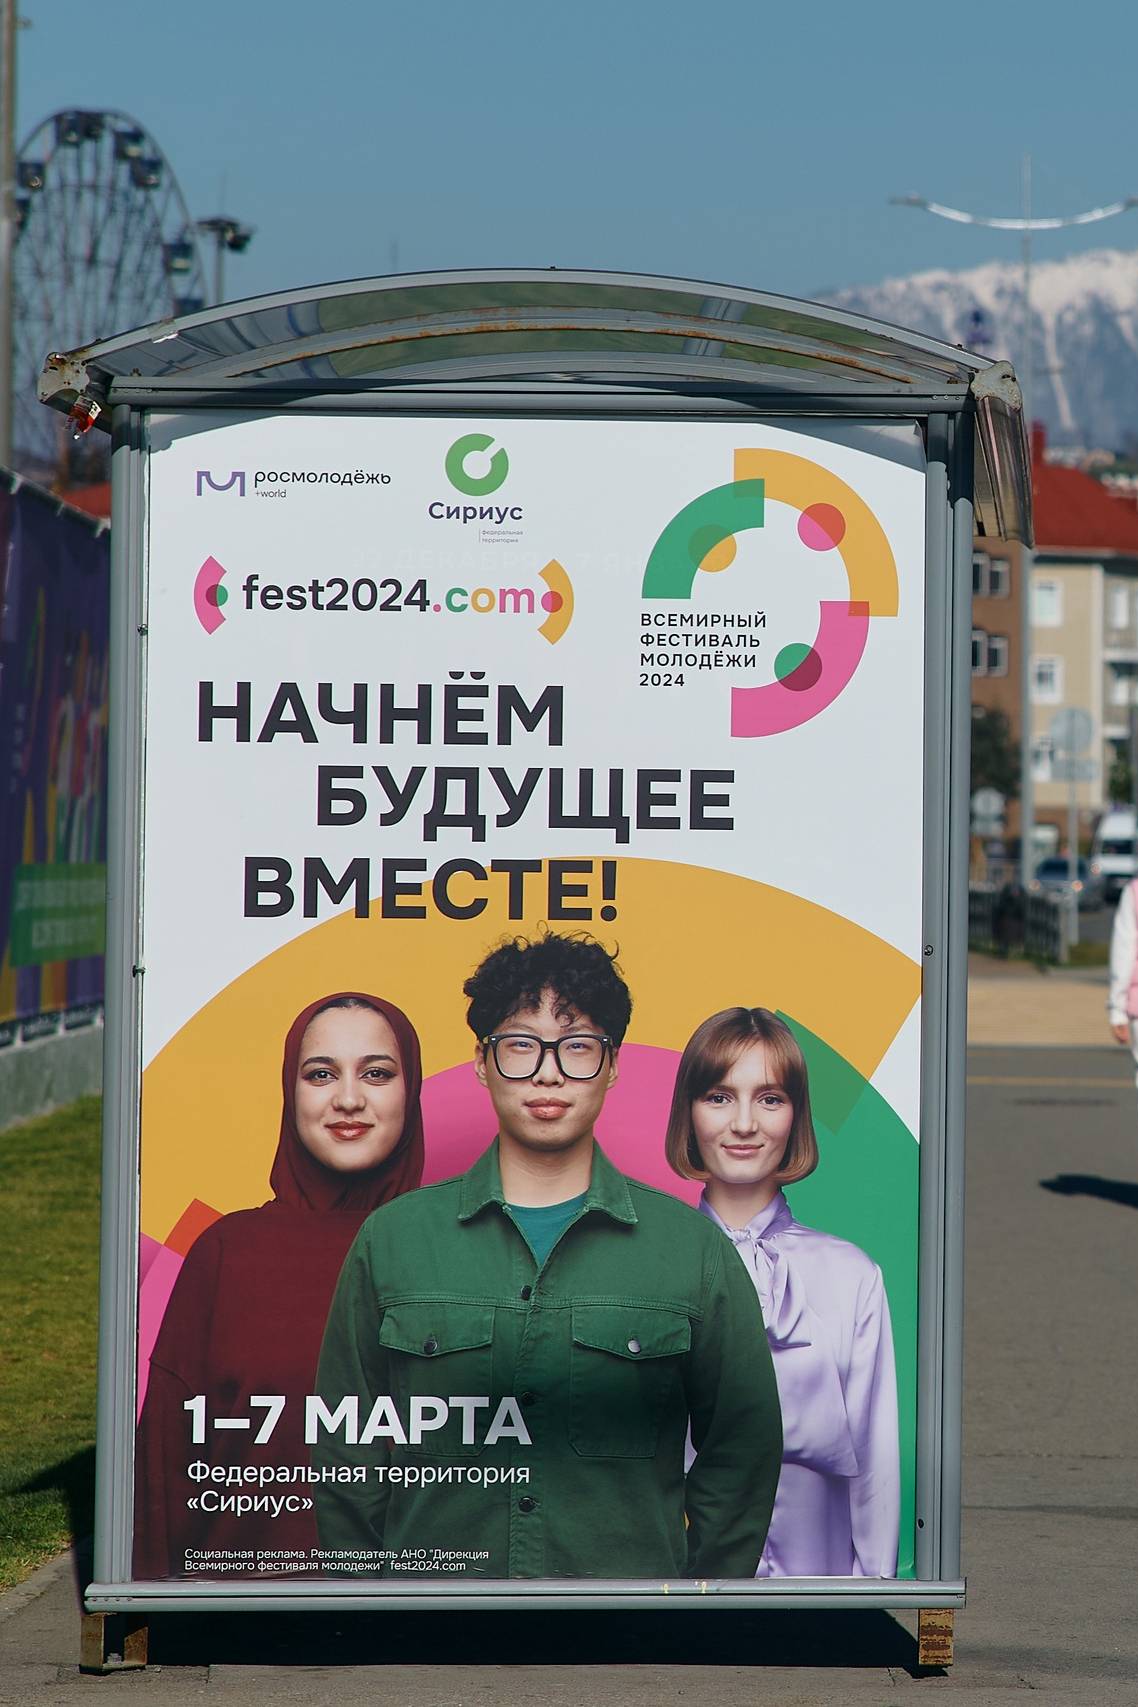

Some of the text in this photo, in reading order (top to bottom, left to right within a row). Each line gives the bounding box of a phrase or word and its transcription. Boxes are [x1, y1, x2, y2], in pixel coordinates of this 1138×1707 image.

[254, 470, 391, 488] росмолодёжь
[255, 489, 287, 499] +world
[428, 501, 523, 525] Сириус
[242, 574, 535, 614] fest2024.com
[641, 611, 766, 628] ВСЕМИРНЫЙ
[640, 633, 760, 648] ФЕСТИВАЛЬ
[640, 650, 756, 670] МОЛОДЁЖИ
[639, 673, 685, 687] 2024
[197, 671, 564, 746] НАЧНЁМ
[317, 765, 735, 843] БУДУЩЕЕ
[243, 855, 618, 921] ВМЕСТЕ!
[305, 1396, 532, 1446] МАРТА
[187, 1460, 530, 1488] Федеральная территория
[187, 1491, 313, 1517] «Сириус»
[185, 1548, 489, 1561] Социальная реклама. Рекламодатель АНО "Дирекция
[185, 1560, 466, 1573] Всемирного фестиваля молодежи" fest2024.com
